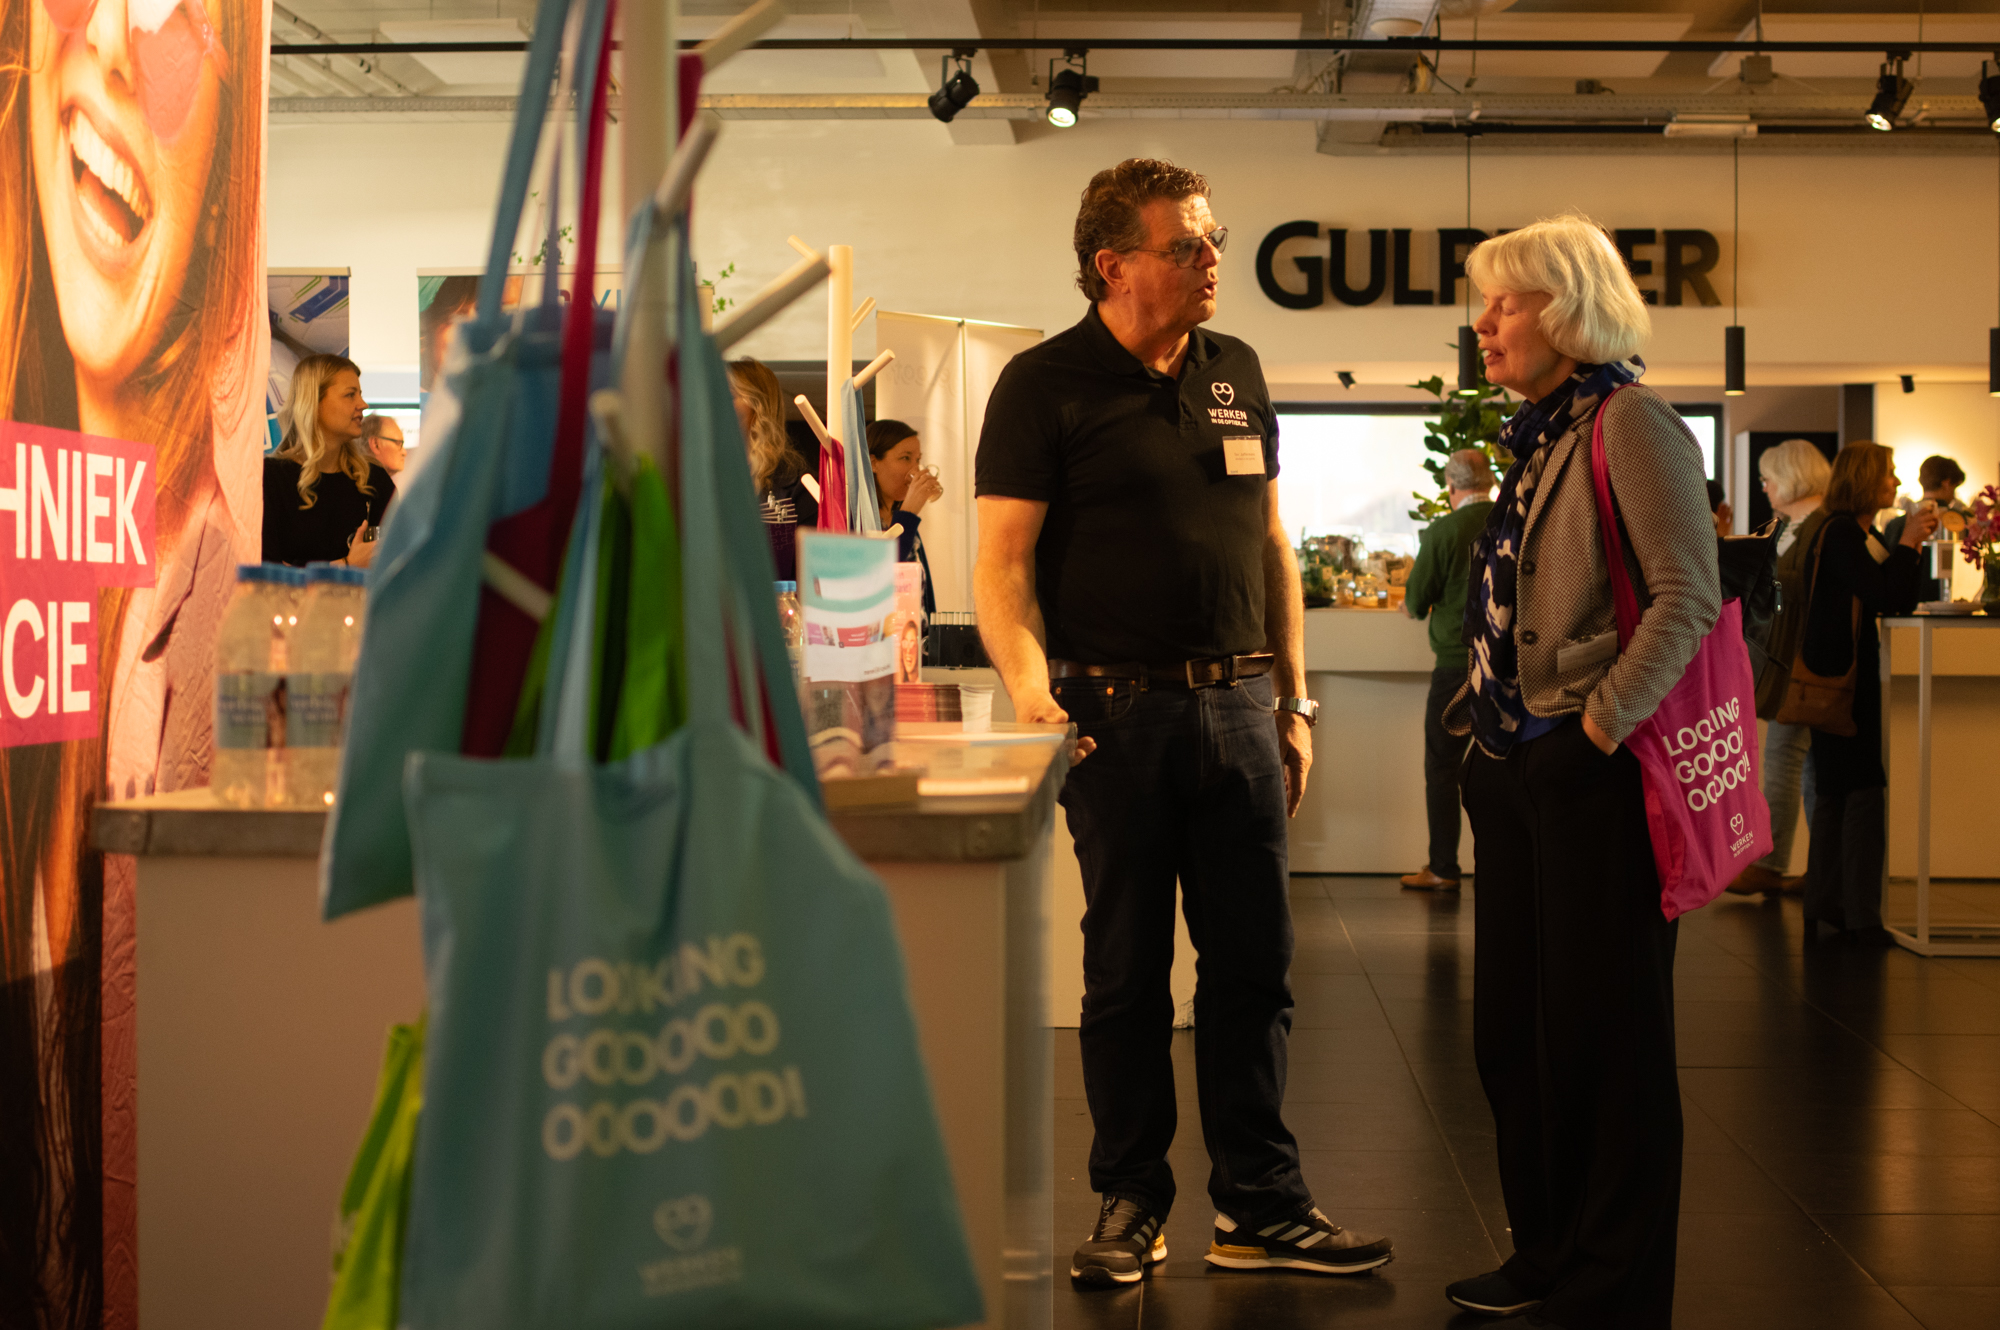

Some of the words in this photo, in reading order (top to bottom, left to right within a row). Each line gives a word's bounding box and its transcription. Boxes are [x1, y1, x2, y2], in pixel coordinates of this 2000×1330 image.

[1256, 219, 1722, 310] GULPER
[1207, 408, 1248, 421] WERKEN
[1729, 830, 1754, 852] WERKEN
